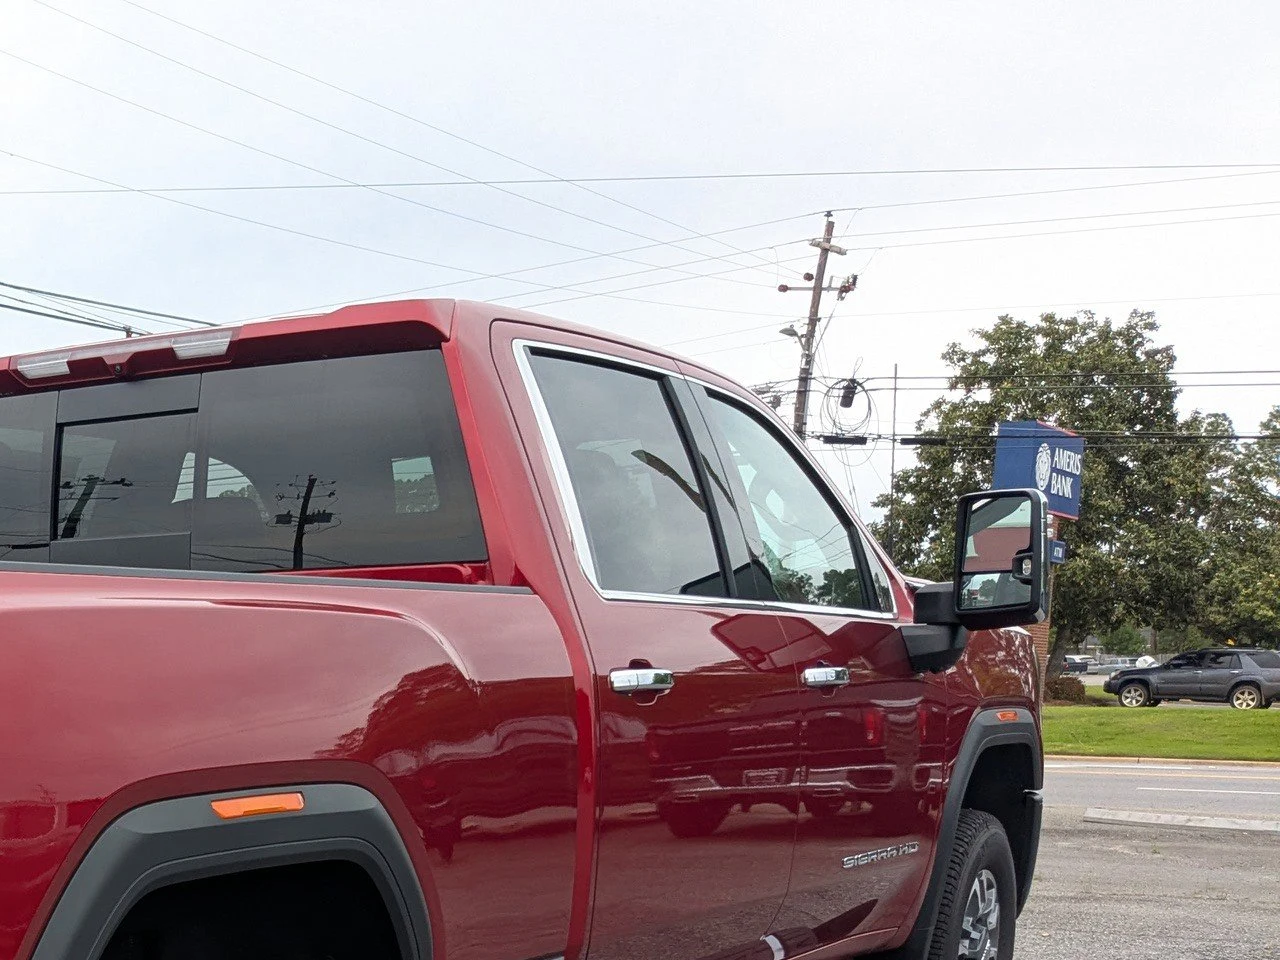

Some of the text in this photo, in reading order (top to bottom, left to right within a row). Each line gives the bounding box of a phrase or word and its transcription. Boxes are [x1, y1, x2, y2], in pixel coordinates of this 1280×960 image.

[1052, 447, 1082, 476] AMERIS
[1051, 473, 1074, 499] BANK
[842, 841, 919, 869] SIERRA HD
